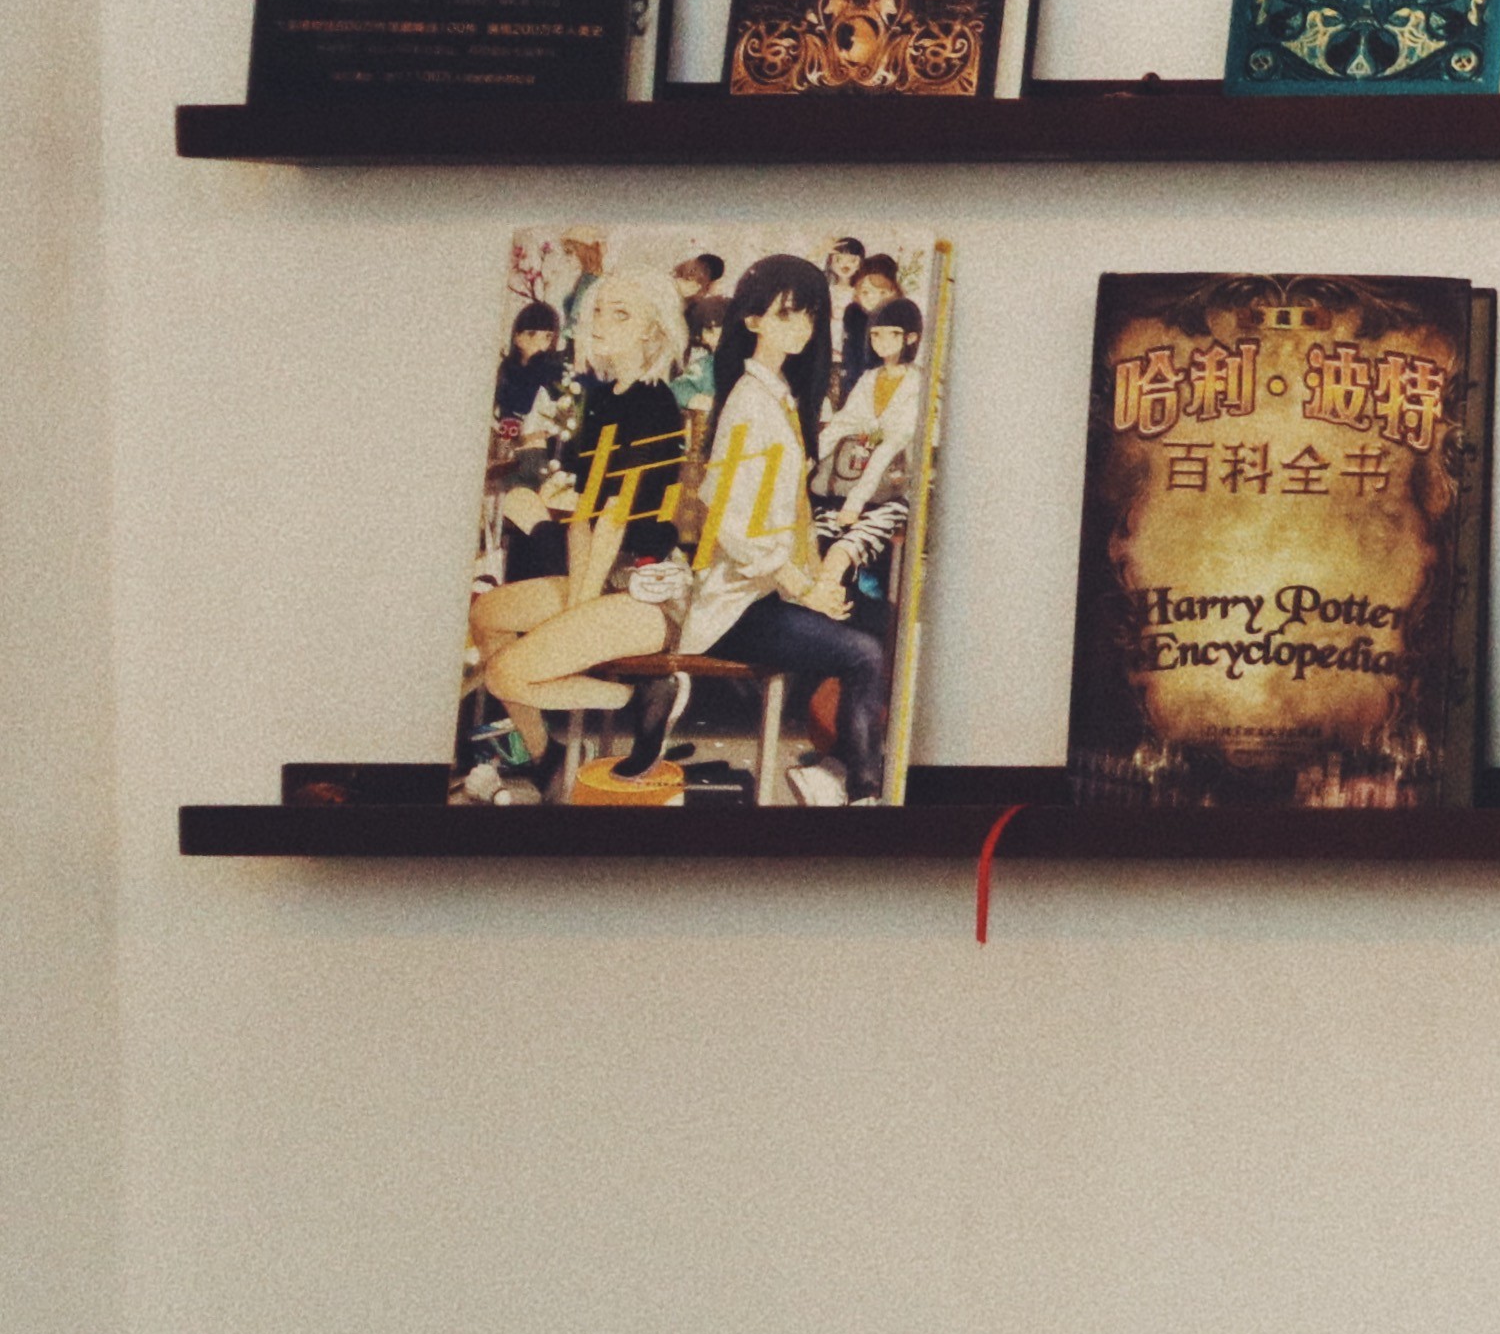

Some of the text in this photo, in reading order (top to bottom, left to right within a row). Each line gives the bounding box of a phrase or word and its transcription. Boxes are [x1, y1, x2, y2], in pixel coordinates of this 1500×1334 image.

[1113, 338, 1445, 452] 哈利·波特
[1163, 442, 1391, 496] 百科全书
[559, 423, 806, 572] 坛九
[1142, 583, 1406, 634] Harry Potter
[1145, 629, 1400, 681] Encyclopedia
